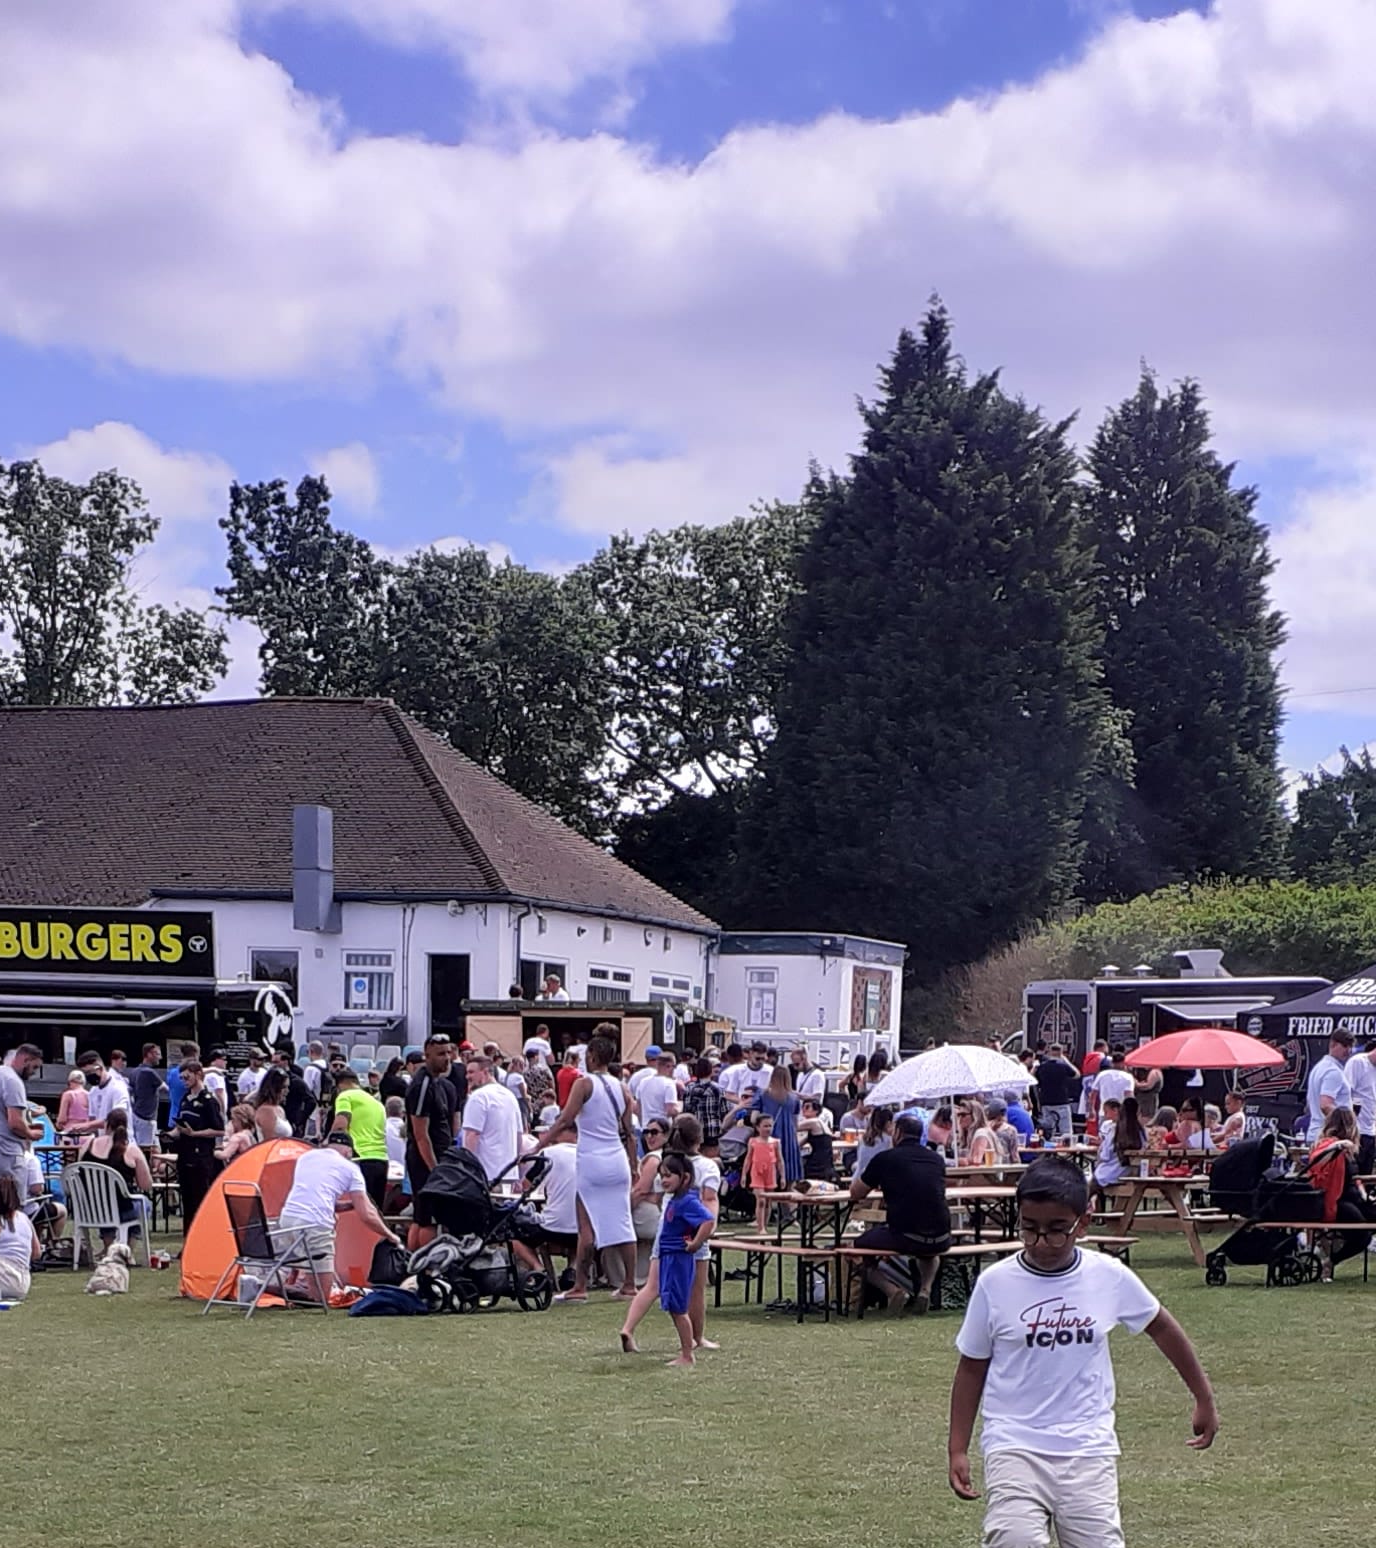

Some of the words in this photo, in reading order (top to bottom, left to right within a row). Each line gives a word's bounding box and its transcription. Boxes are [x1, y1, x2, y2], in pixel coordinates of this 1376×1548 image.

[1288, 1016, 1333, 1036] FRIED
[1020, 1297, 1096, 1351] Future
[1026, 1328, 1094, 1348] ICON
